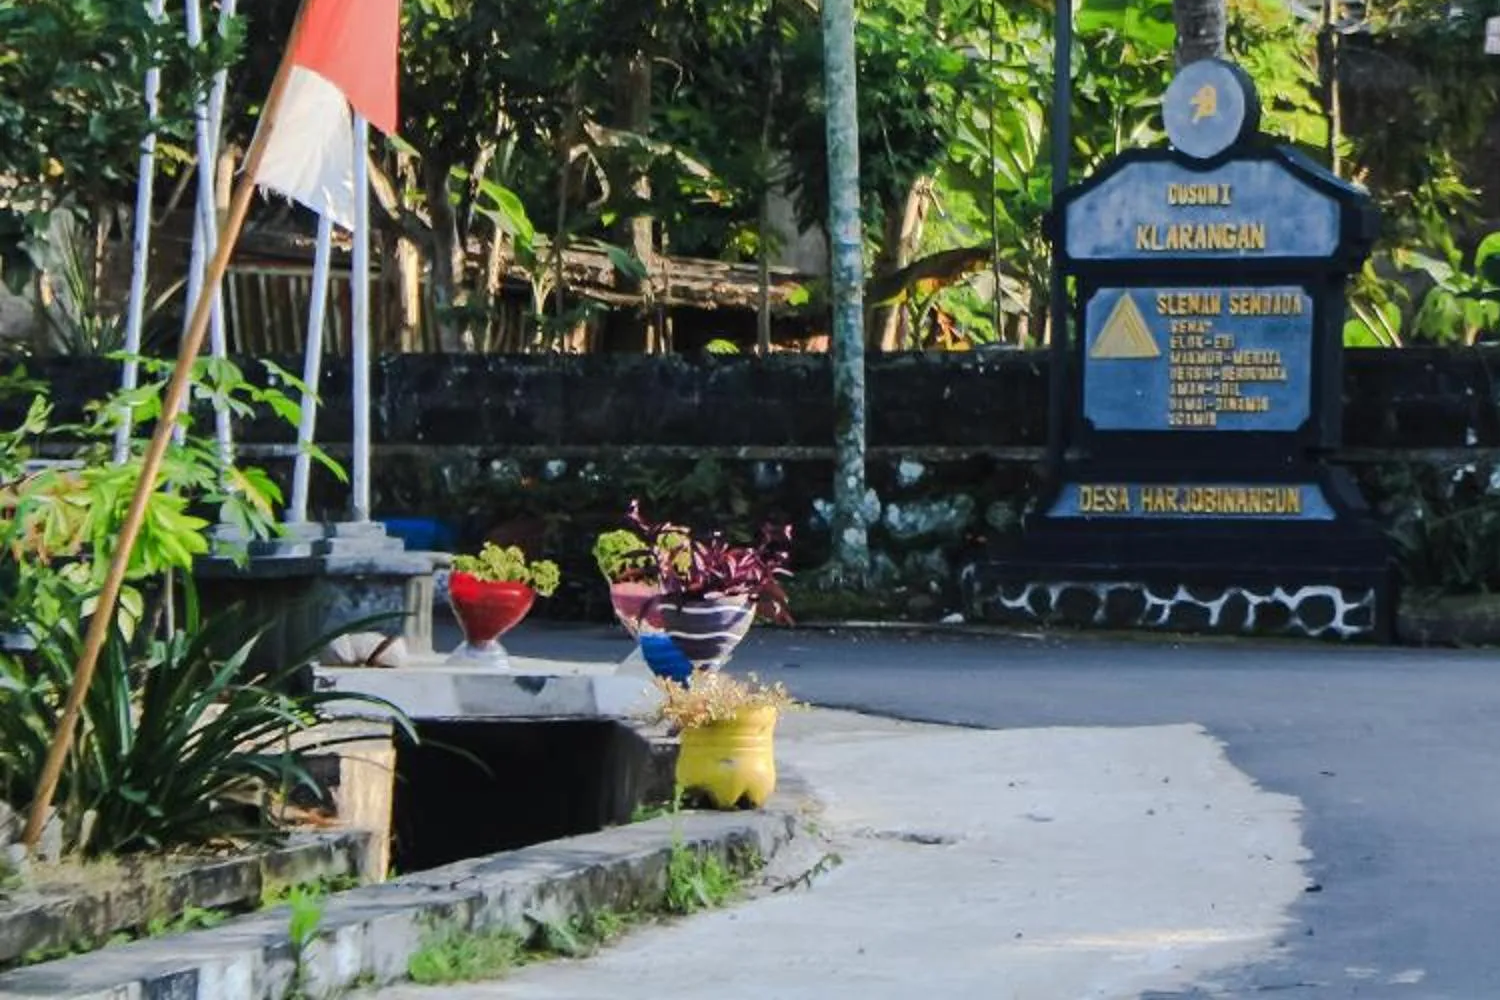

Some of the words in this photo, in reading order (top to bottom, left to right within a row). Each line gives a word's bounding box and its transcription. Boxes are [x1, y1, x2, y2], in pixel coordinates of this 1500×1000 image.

[1136, 223, 1265, 250] KLARANGAN
[1157, 292, 1221, 315] SLEMAN
[1080, 486, 1130, 512] DESA
[1141, 487, 1302, 513] HARJOBINANGUN
